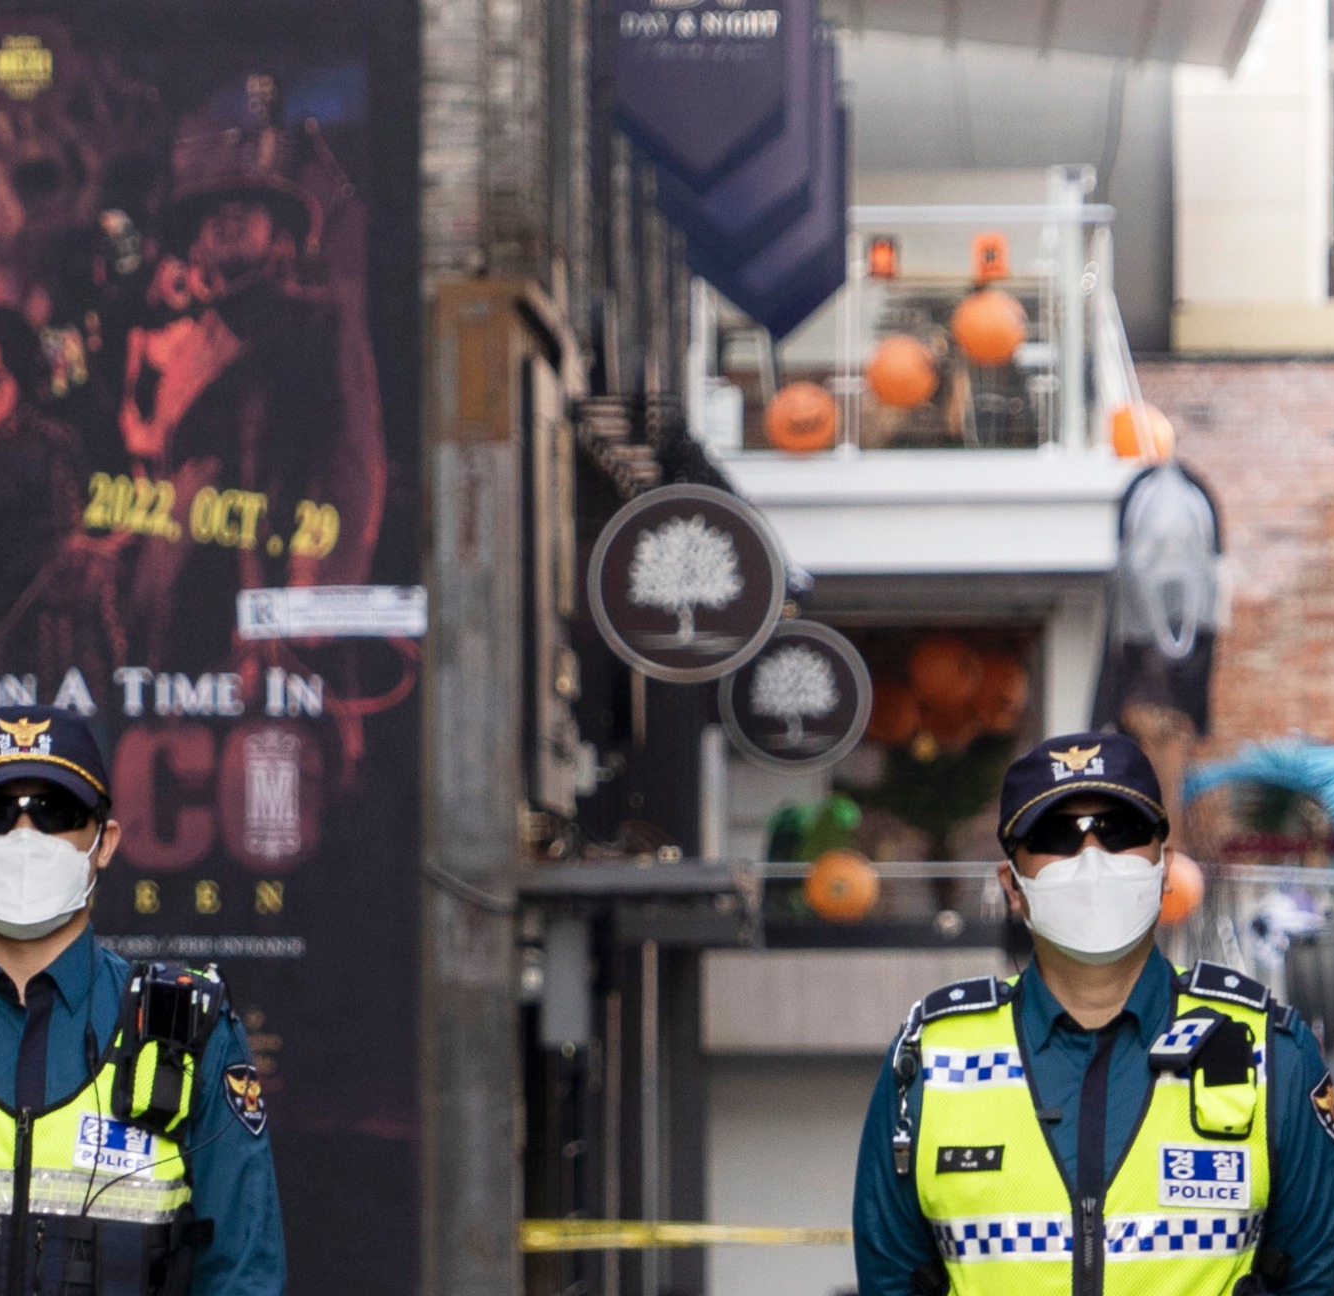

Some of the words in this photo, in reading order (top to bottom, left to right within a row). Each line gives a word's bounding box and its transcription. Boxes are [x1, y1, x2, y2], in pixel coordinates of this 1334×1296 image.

[289, 499, 340, 560] 29
[53, 667, 96, 717] A
[113, 666, 244, 717] TIME
[267, 666, 324, 717] IN
[85, 1118, 148, 1154] 경찰
[81, 1149, 146, 1171] POLICE
[1167, 1150, 1240, 1181] 경찰
[1168, 1185, 1240, 1200] POLICE
